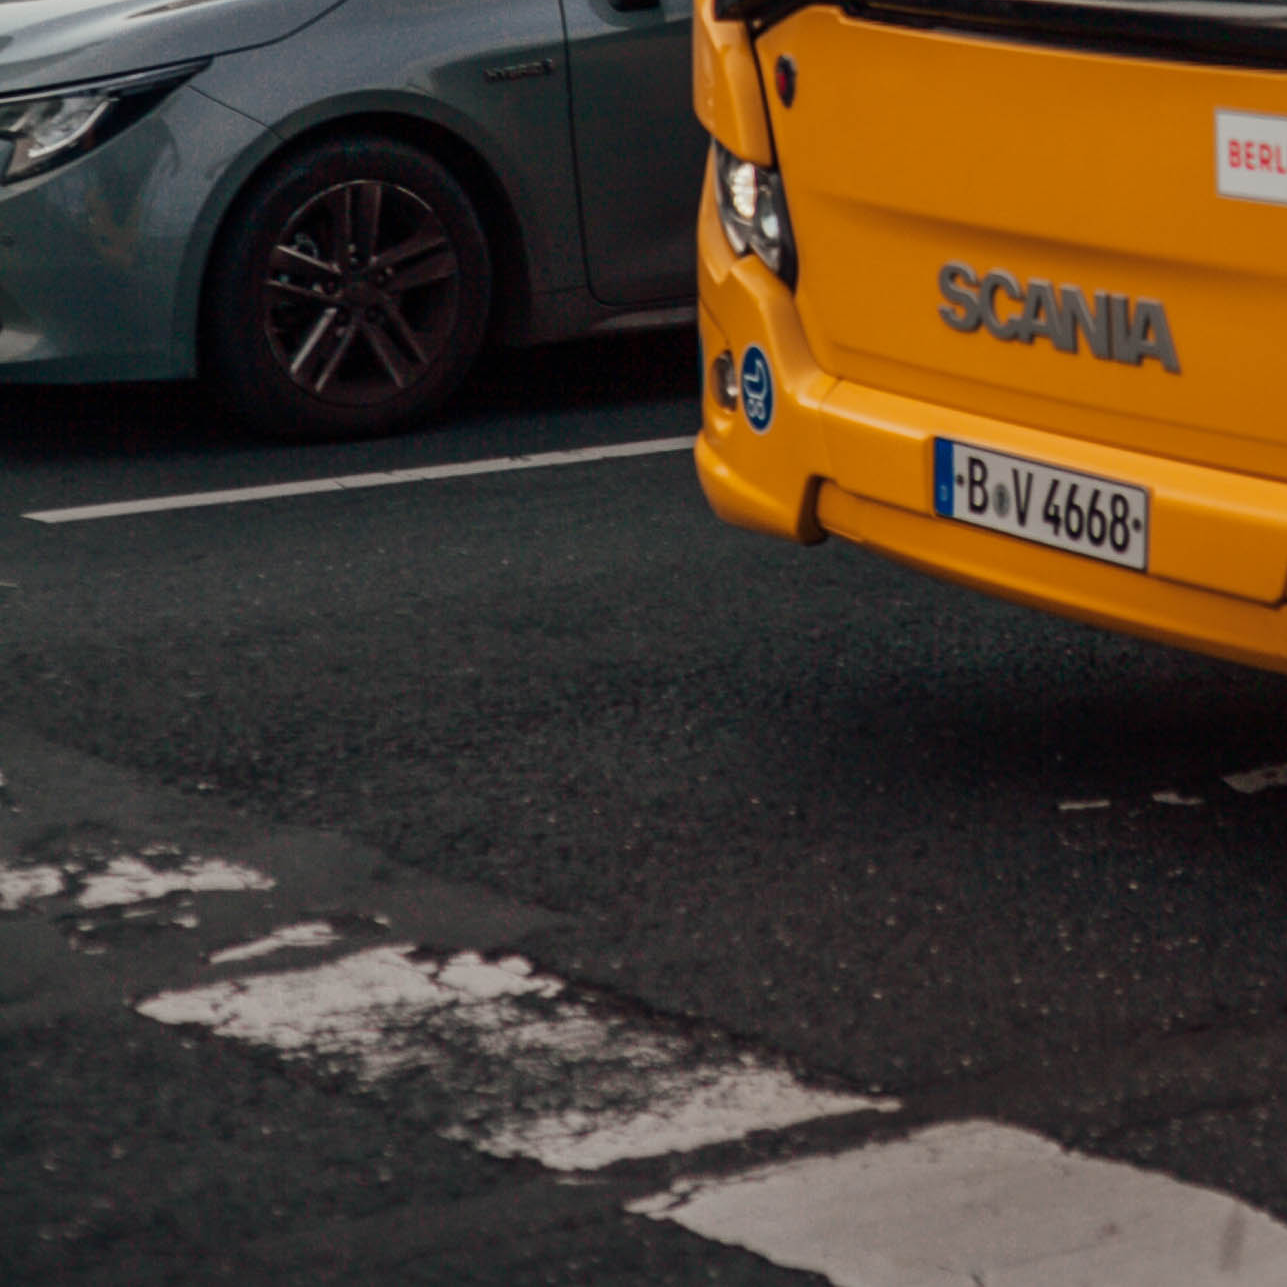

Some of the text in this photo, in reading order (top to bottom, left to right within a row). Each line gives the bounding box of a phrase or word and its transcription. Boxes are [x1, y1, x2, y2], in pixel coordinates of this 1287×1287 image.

[936, 259, 1183, 376] SCANIA
[967, 455, 1132, 555] B V 4668
